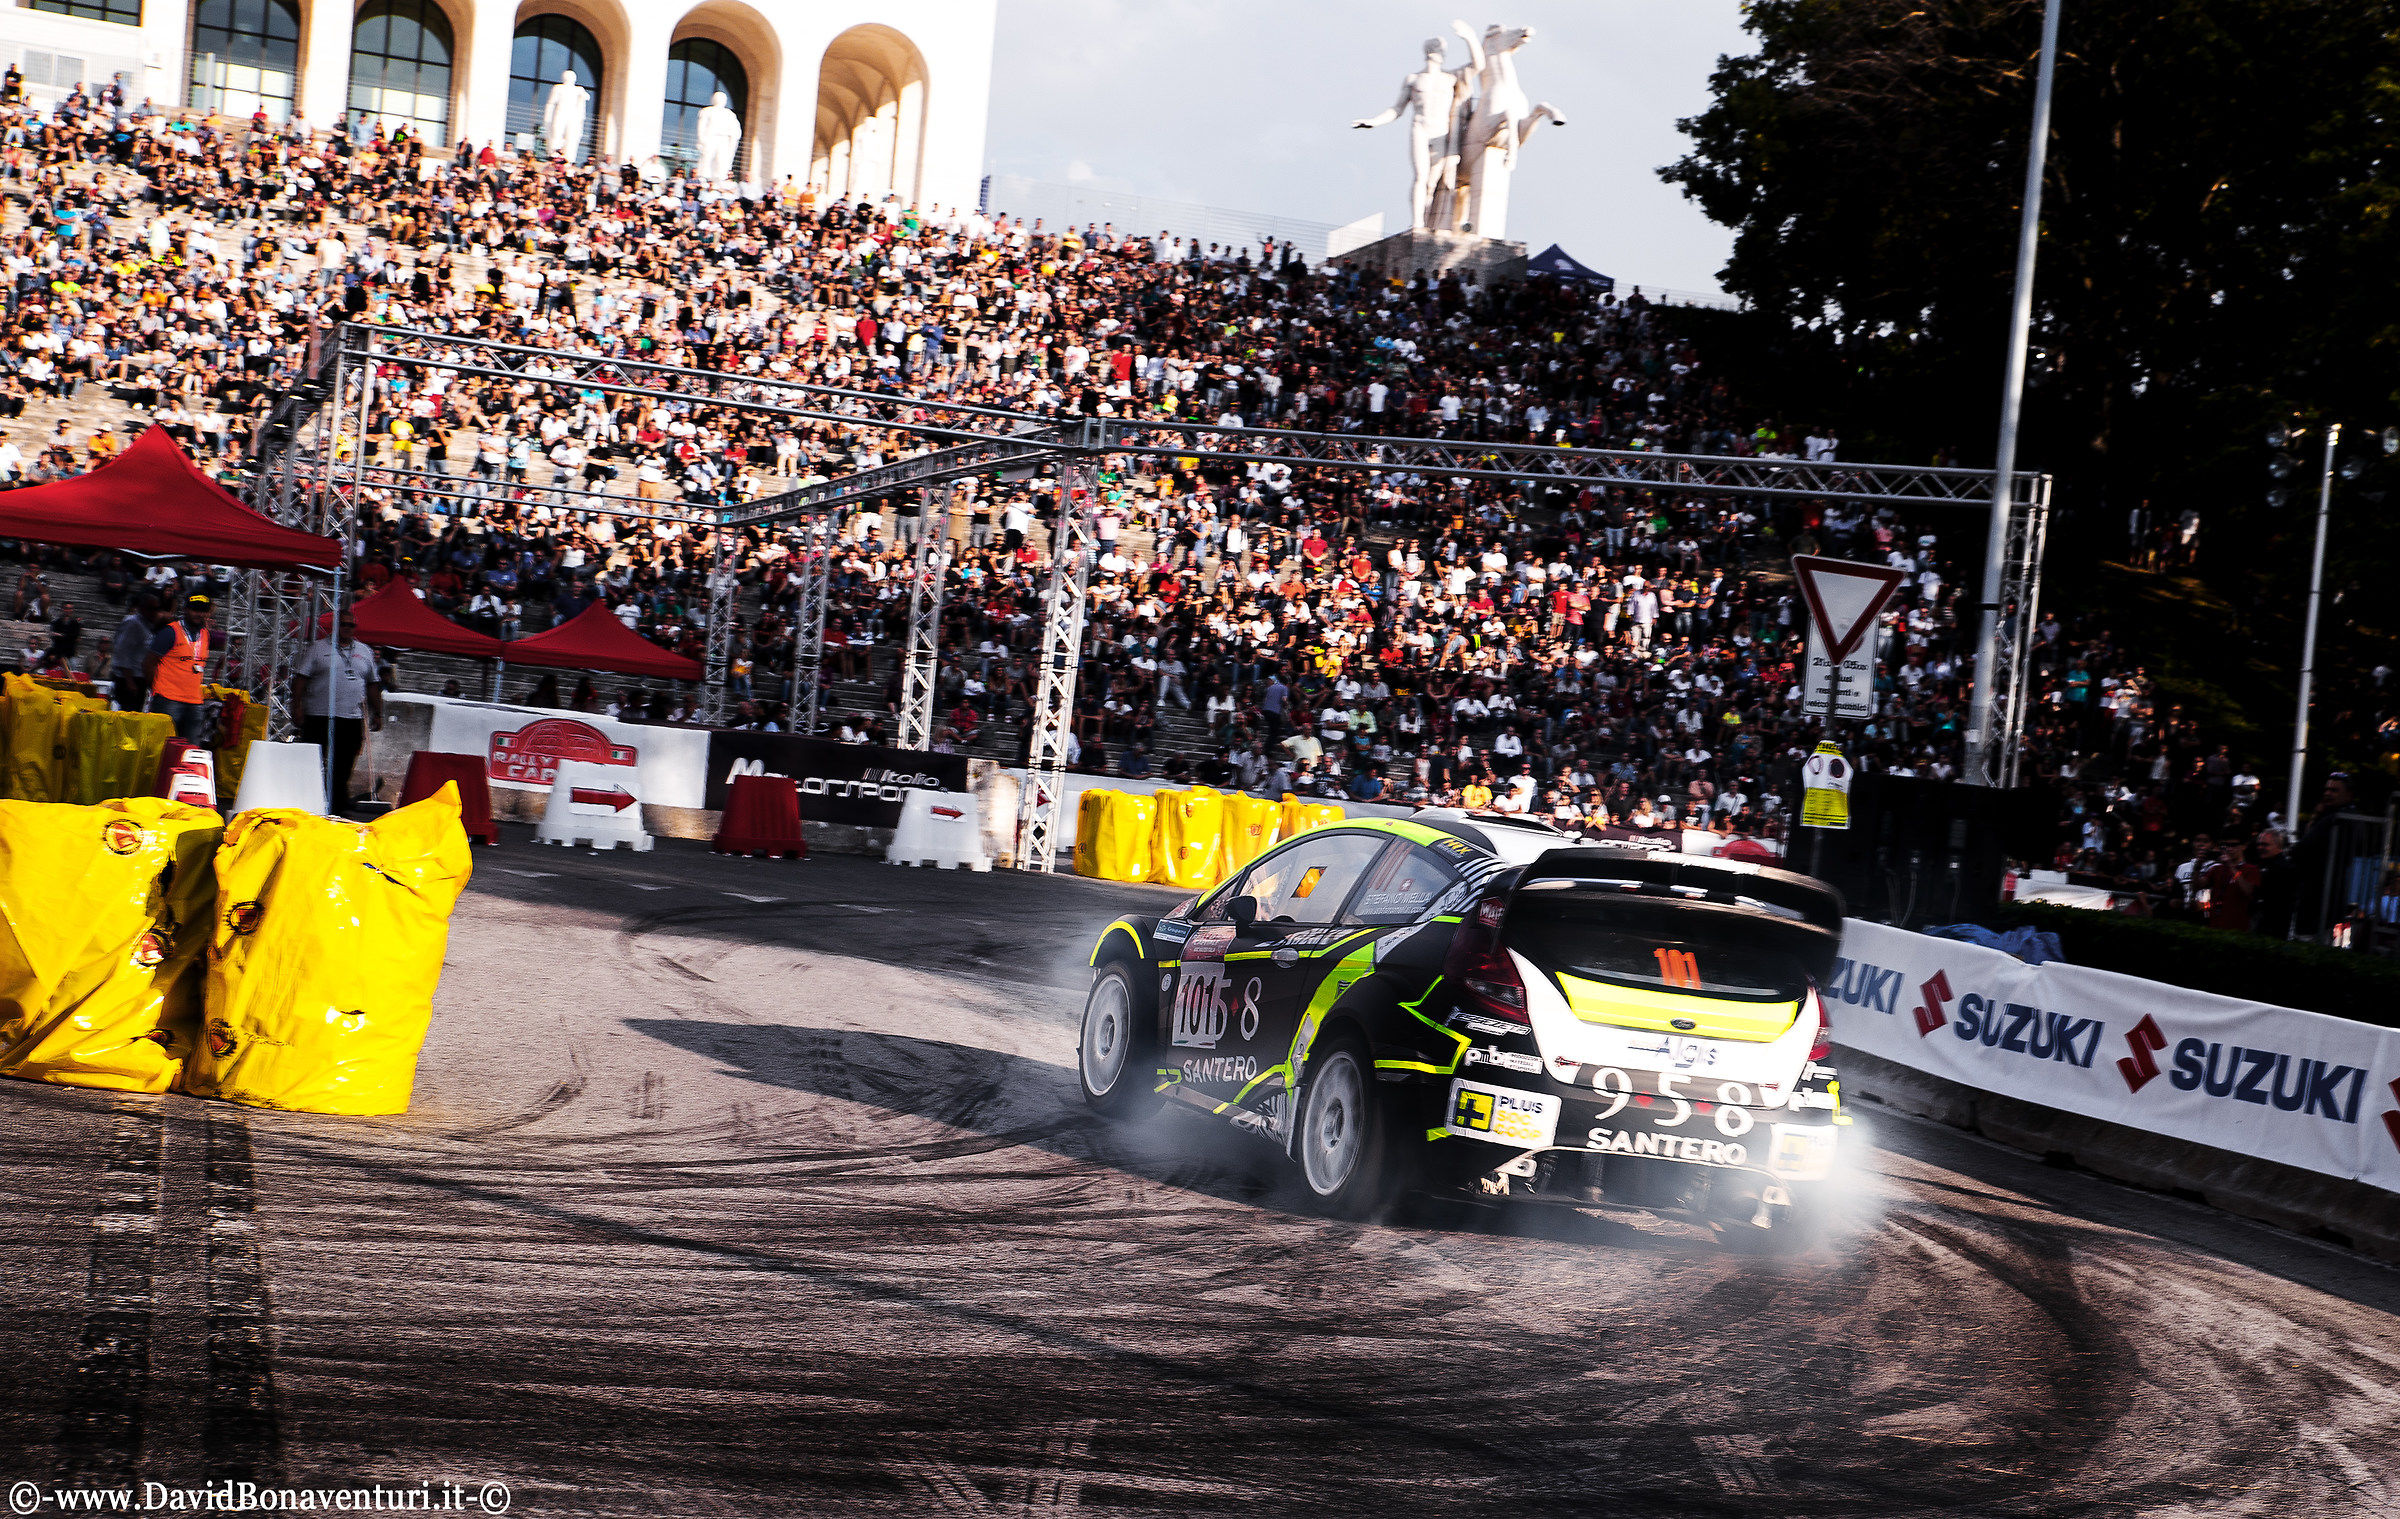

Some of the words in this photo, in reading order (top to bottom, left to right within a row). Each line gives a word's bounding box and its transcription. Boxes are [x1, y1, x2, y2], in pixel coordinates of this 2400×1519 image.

[494, 751, 553, 767] RALLY
[1653, 948, 1702, 990] 101
[1954, 992, 2106, 1069] SUZUKI
[1183, 1055, 1258, 1084] SANTERO
[2168, 1037, 2368, 1124] SUZUKI
[1498, 1096, 1543, 1114] PLUS
[1586, 1127, 1748, 1165] SANTERO
